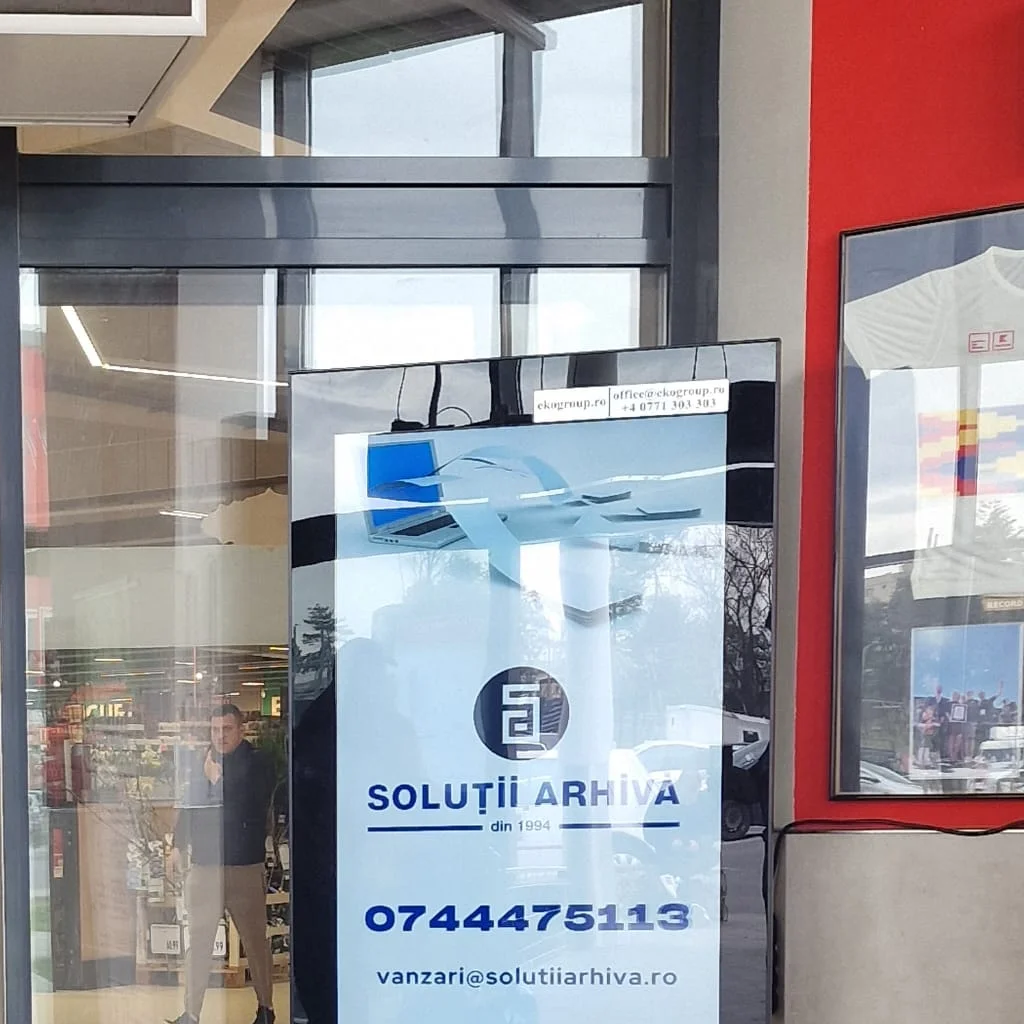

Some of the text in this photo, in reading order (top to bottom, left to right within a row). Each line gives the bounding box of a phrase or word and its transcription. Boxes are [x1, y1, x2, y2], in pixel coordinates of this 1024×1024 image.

[613, 386, 725, 401] office@ekogroup.ro
[537, 398, 606, 410] ekogroup.ro
[622, 398, 716, 412] +4 0771 303 303
[490, 820, 551, 832] din 1994
[364, 904, 690, 931] 0744475113
[377, 967, 678, 988] vanzari@solutiiarhiva.ro
